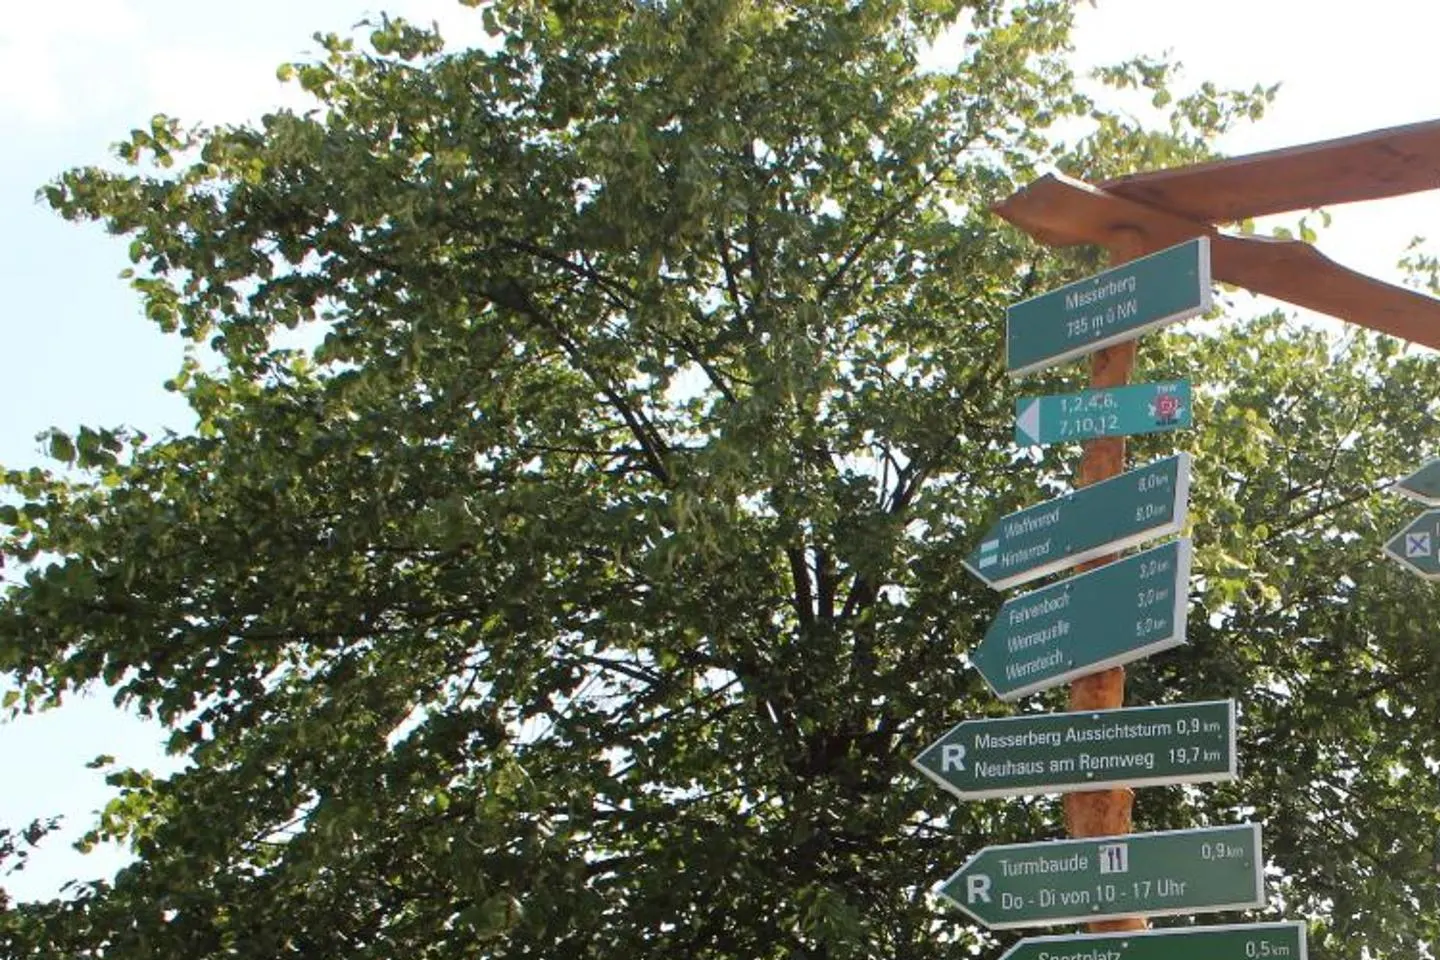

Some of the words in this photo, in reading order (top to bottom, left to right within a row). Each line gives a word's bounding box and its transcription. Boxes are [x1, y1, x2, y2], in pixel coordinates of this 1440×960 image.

[1066, 317, 1088, 338] 785
[1092, 314, 1104, 330] m
[1117, 299, 1137, 317] NN
[975, 730, 1062, 750] Masserberg
[1065, 722, 1172, 743] Aussichtsturm
[941, 744, 967, 772] R
[975, 756, 1045, 778] Neuhaus
[1050, 758, 1075, 773] am
[1079, 750, 1155, 771] Rennweg
[1168, 747, 1200, 765] 19,7
[1000, 855, 1088, 877] Turmbaude
[967, 873, 993, 904] R
[1001, 891, 1023, 911] Do
[1039, 888, 1057, 908] Di
[1061, 890, 1090, 904] von
[1096, 885, 1116, 903] 10
[1132, 881, 1151, 899] 17
[1157, 878, 1186, 897] Uhr
